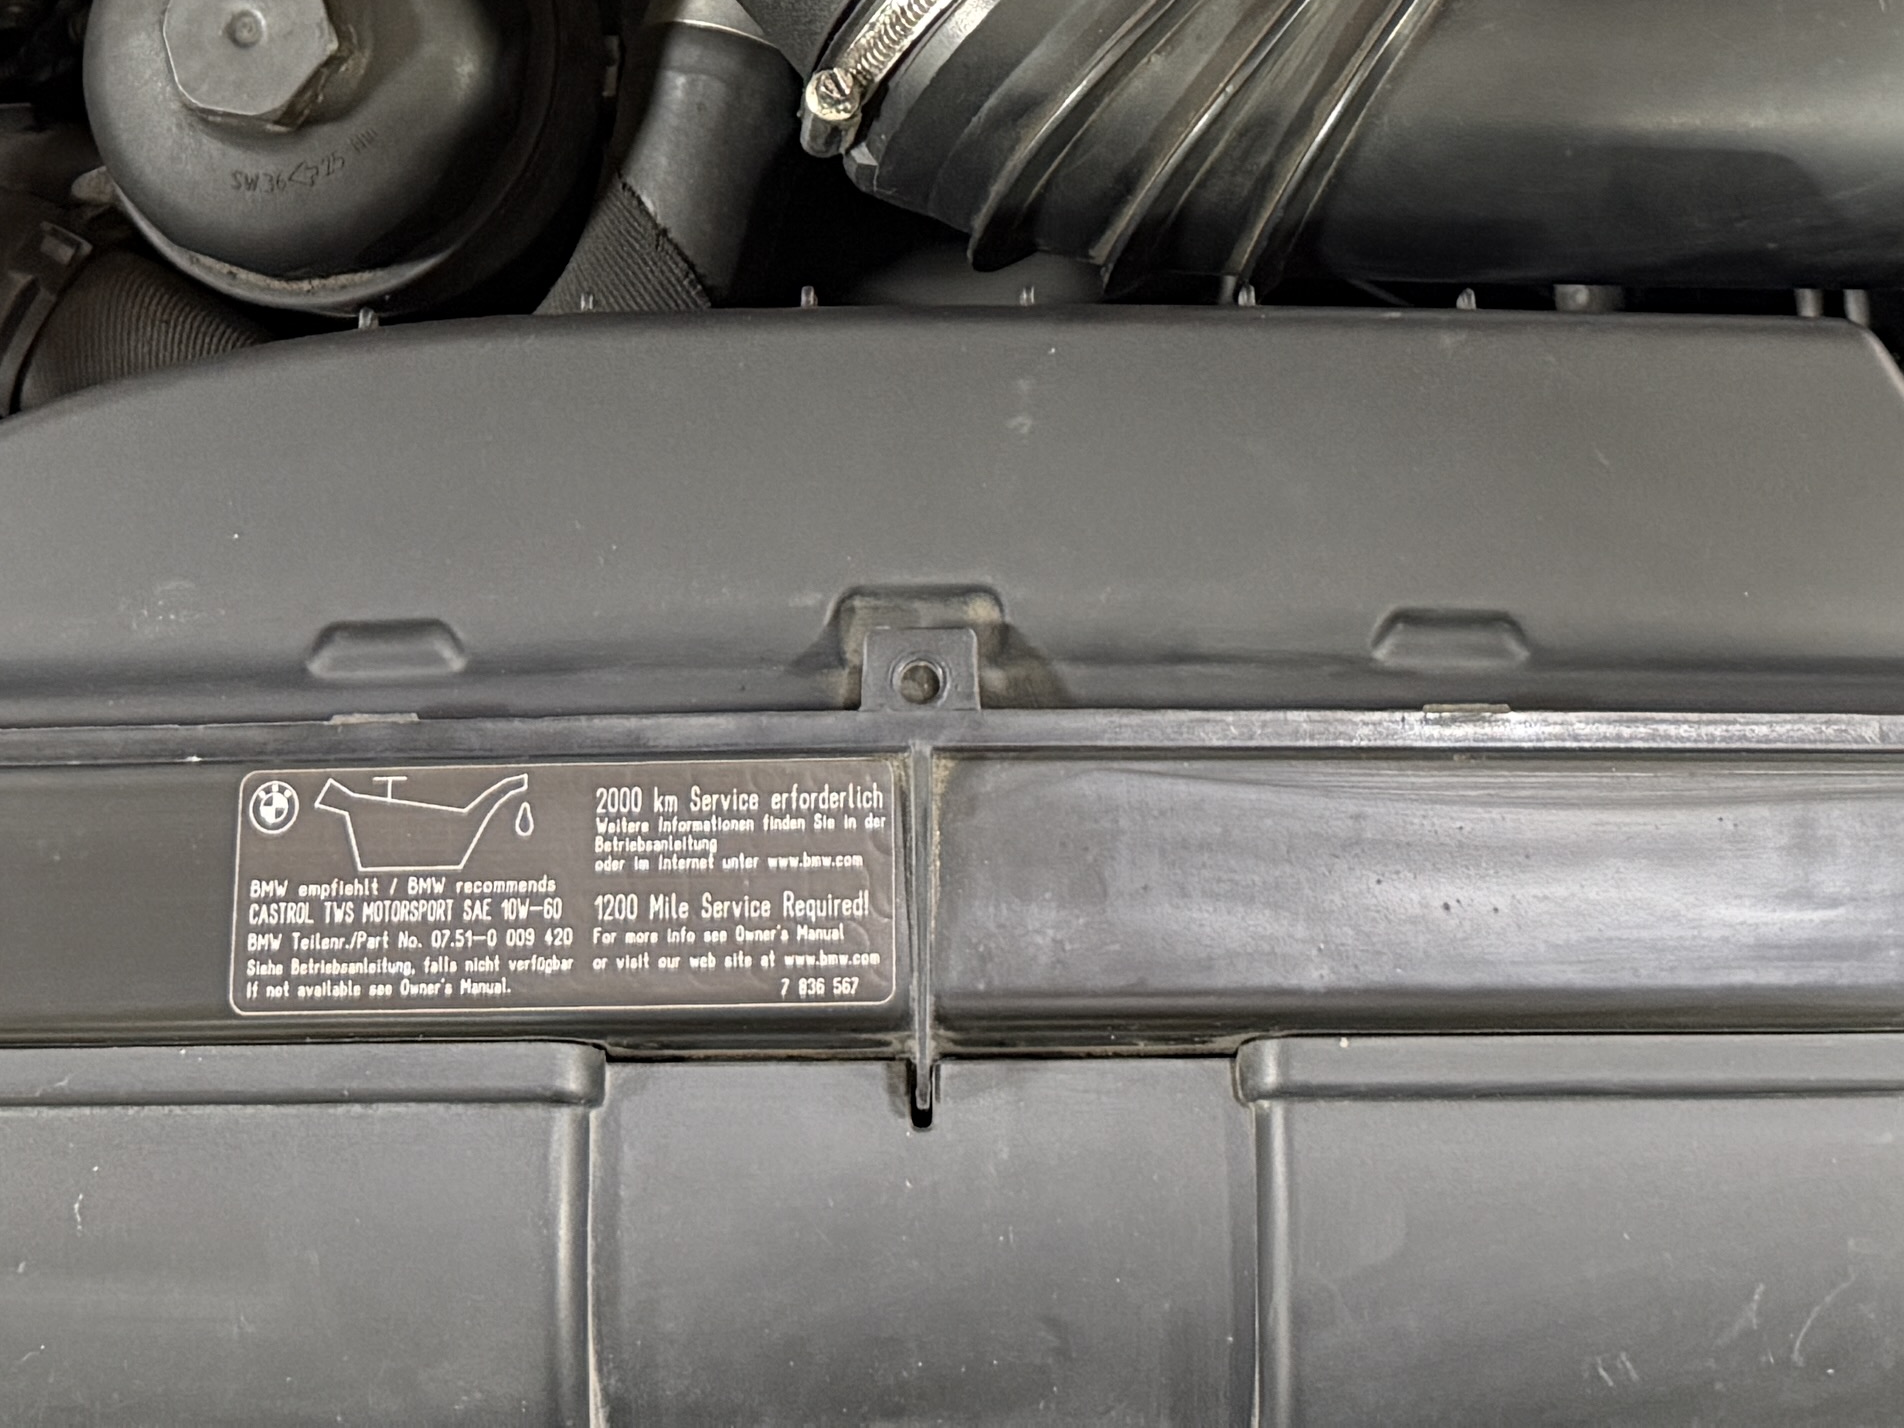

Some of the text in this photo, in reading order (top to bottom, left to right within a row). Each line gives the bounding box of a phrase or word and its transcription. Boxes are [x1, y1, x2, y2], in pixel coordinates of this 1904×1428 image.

[596, 783, 884, 813] 2000 km Service erforderlich
[597, 813, 885, 833] Weitere Informationen finden Sie in der
[595, 837, 717, 853] Betriebsanleitung
[595, 853, 863, 872] oder im Internet unter www.bmw.com
[250, 879, 287, 897] BMW
[299, 878, 379, 898] empfiehlt
[407, 877, 445, 894] BMW
[456, 875, 556, 894] recommends
[248, 898, 562, 924] CASTROL TWS MOTORSPORT SAE 10W-60
[595, 890, 869, 922] 1200 Mile Service Required!
[248, 934, 280, 952] BMW
[292, 931, 389, 951] Teilenr./Part
[398, 931, 422, 949] No.
[506, 929, 534, 948] 009
[545, 928, 573, 947] 420
[593, 923, 844, 944] For more info see Owner's Manual
[247, 958, 283, 975] Siehe
[291, 957, 415, 976] Betriebsanleitung,
[424, 956, 457, 973] falls
[465, 955, 500, 973] nicht
[593, 950, 880, 970] or visit our web site at www.bmw.com
[247, 977, 511, 998] If not available see Owner's Manual.
[780, 978, 790, 998] 7
[834, 977, 859, 994] 567
